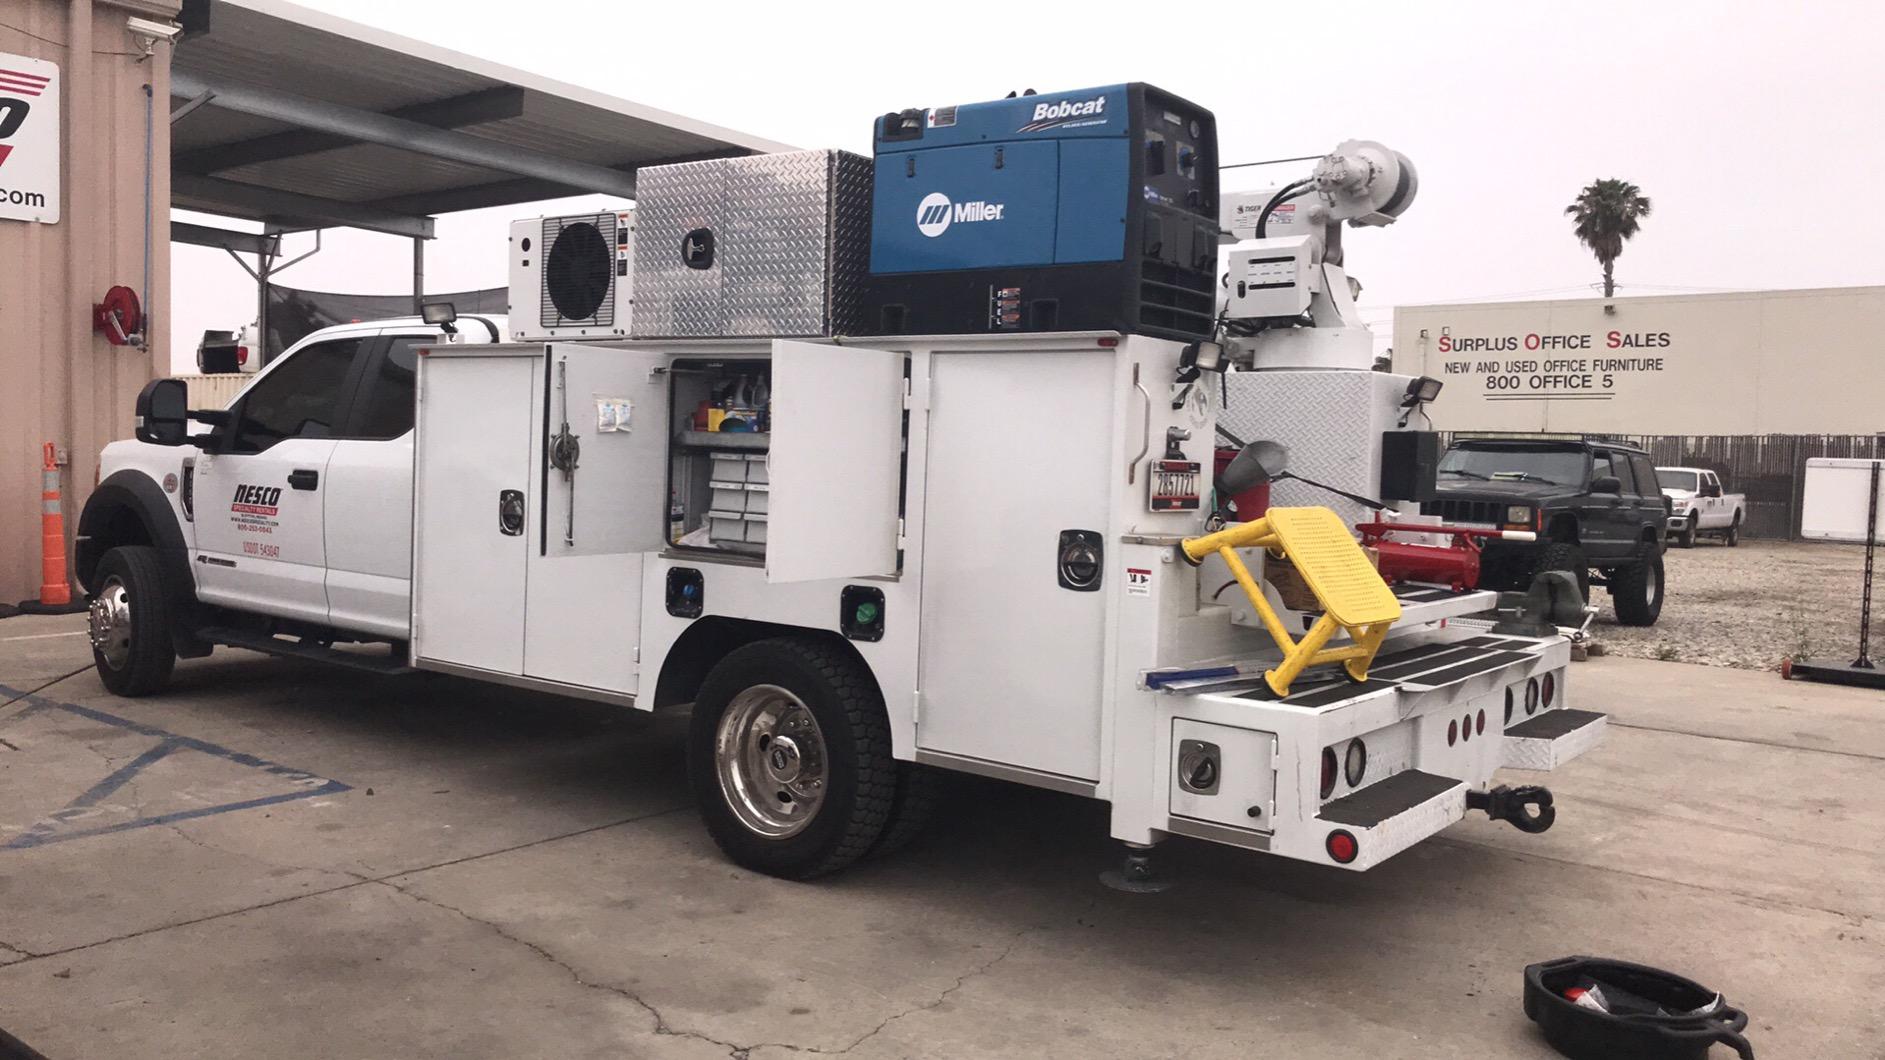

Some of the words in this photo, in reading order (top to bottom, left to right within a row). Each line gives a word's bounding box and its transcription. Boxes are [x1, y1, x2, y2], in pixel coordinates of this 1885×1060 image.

[1032, 96, 1105, 121] Bobcat
[954, 201, 1004, 223] Miller
[1439, 336, 1518, 353] SURPLUS
[1524, 333, 1592, 350] OFFICE
[1606, 330, 1671, 349] SALES
[1444, 361, 1472, 374] NEW
[1476, 361, 1500, 374] AND
[1505, 360, 1538, 373] USED
[1543, 359, 1587, 373] OFFICE
[1593, 358, 1664, 372] FURNITURE
[1486, 375, 1521, 389] 800
[1529, 374, 1593, 389] OFFICE
[1602, 374, 1614, 389] 5
[233, 484, 282, 507] NESCO
